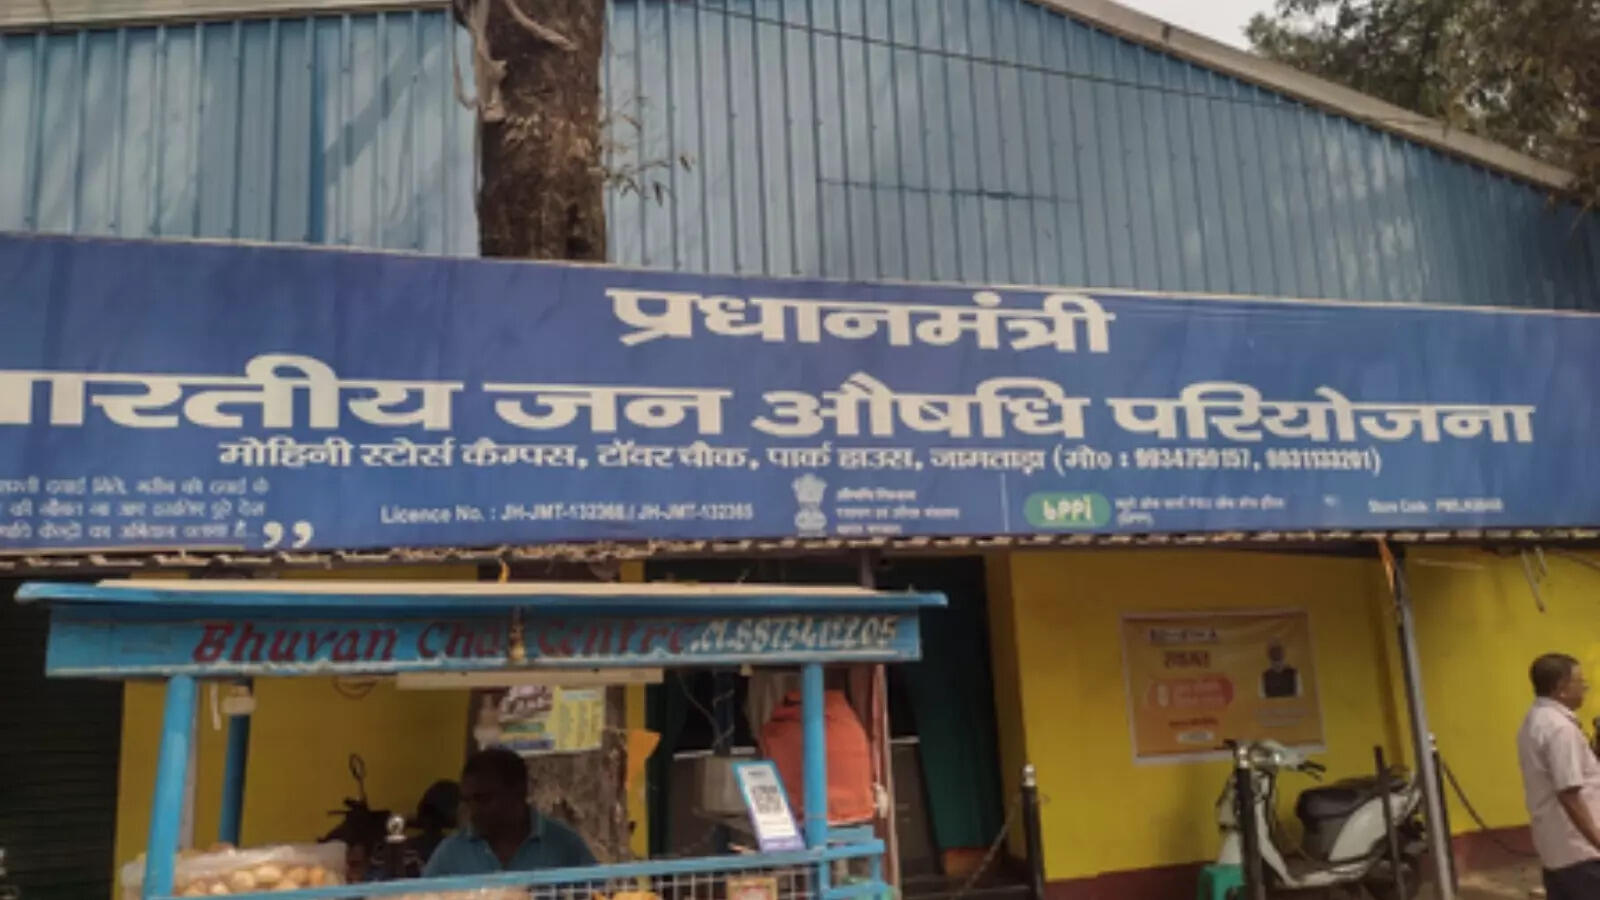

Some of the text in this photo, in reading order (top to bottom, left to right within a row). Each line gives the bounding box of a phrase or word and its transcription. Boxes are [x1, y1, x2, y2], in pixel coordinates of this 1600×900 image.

[605, 288, 1116, 353] प्रधानमंत्री
[0, 353, 1536, 443] ारतीय जन औषधि परियोजना
[218, 436, 353, 467] मोहिनी
[380, 504, 451, 525] Licence
[192, 619, 399, 662] Bhuvan
[417, 621, 511, 659] Cha
